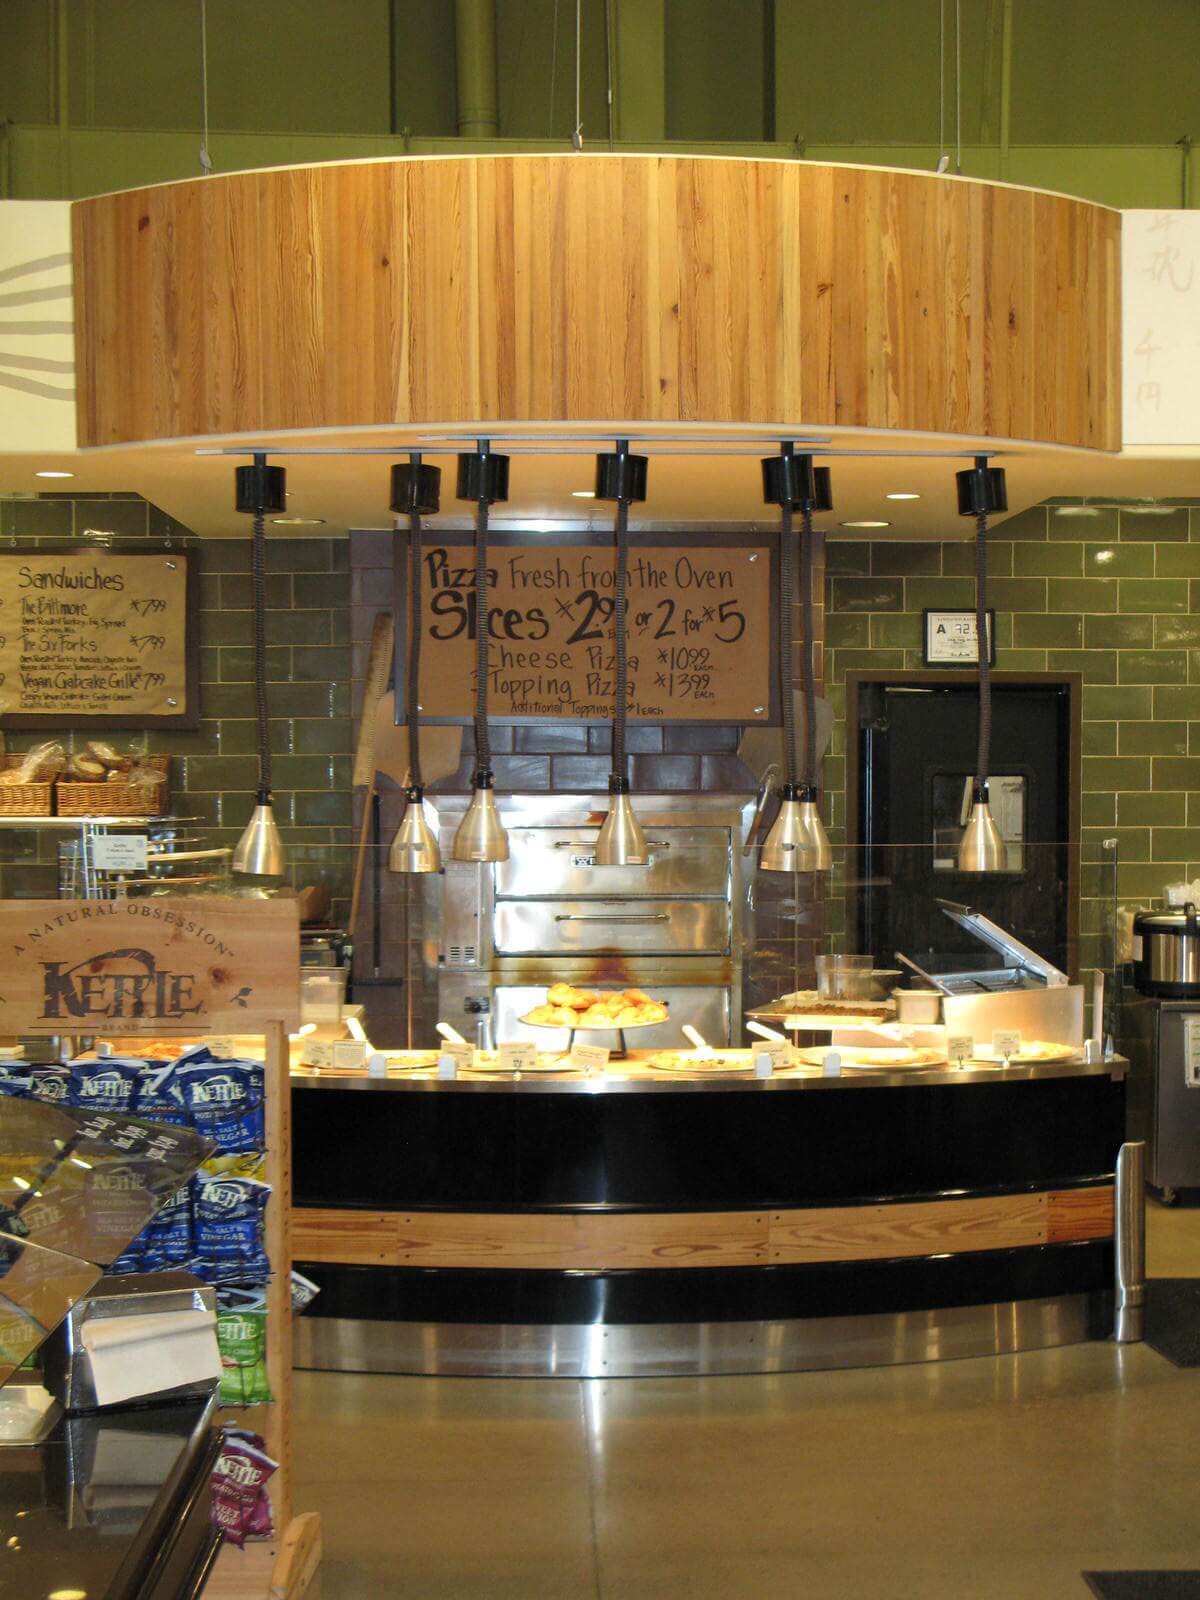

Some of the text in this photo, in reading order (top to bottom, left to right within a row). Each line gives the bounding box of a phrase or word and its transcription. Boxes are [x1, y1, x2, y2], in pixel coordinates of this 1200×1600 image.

[18, 566, 124, 591] Sandwiches
[424, 548, 498, 589] Pizza
[508, 555, 571, 589] Fresh
[633, 557, 667, 589] the
[675, 556, 734, 589] Oven
[429, 590, 549, 640] Slces
[635, 611, 652, 627] or
[654, 598, 676, 640] 2
[682, 609, 702, 636] for
[936, 624, 946, 634] A
[585, 645, 640, 672] Piza
[487, 668, 572, 703] Topping
[510, 701, 563, 713] Additional
[14, 944, 25, 957] A
[28, 903, 118, 943] NATURAL
[37, 948, 207, 1019] KETTLE
[101, 1023, 140, 1032] BRAND
[190, 1075, 248, 1104] KETTLE
[217, 1315, 258, 1340] ETTLE
